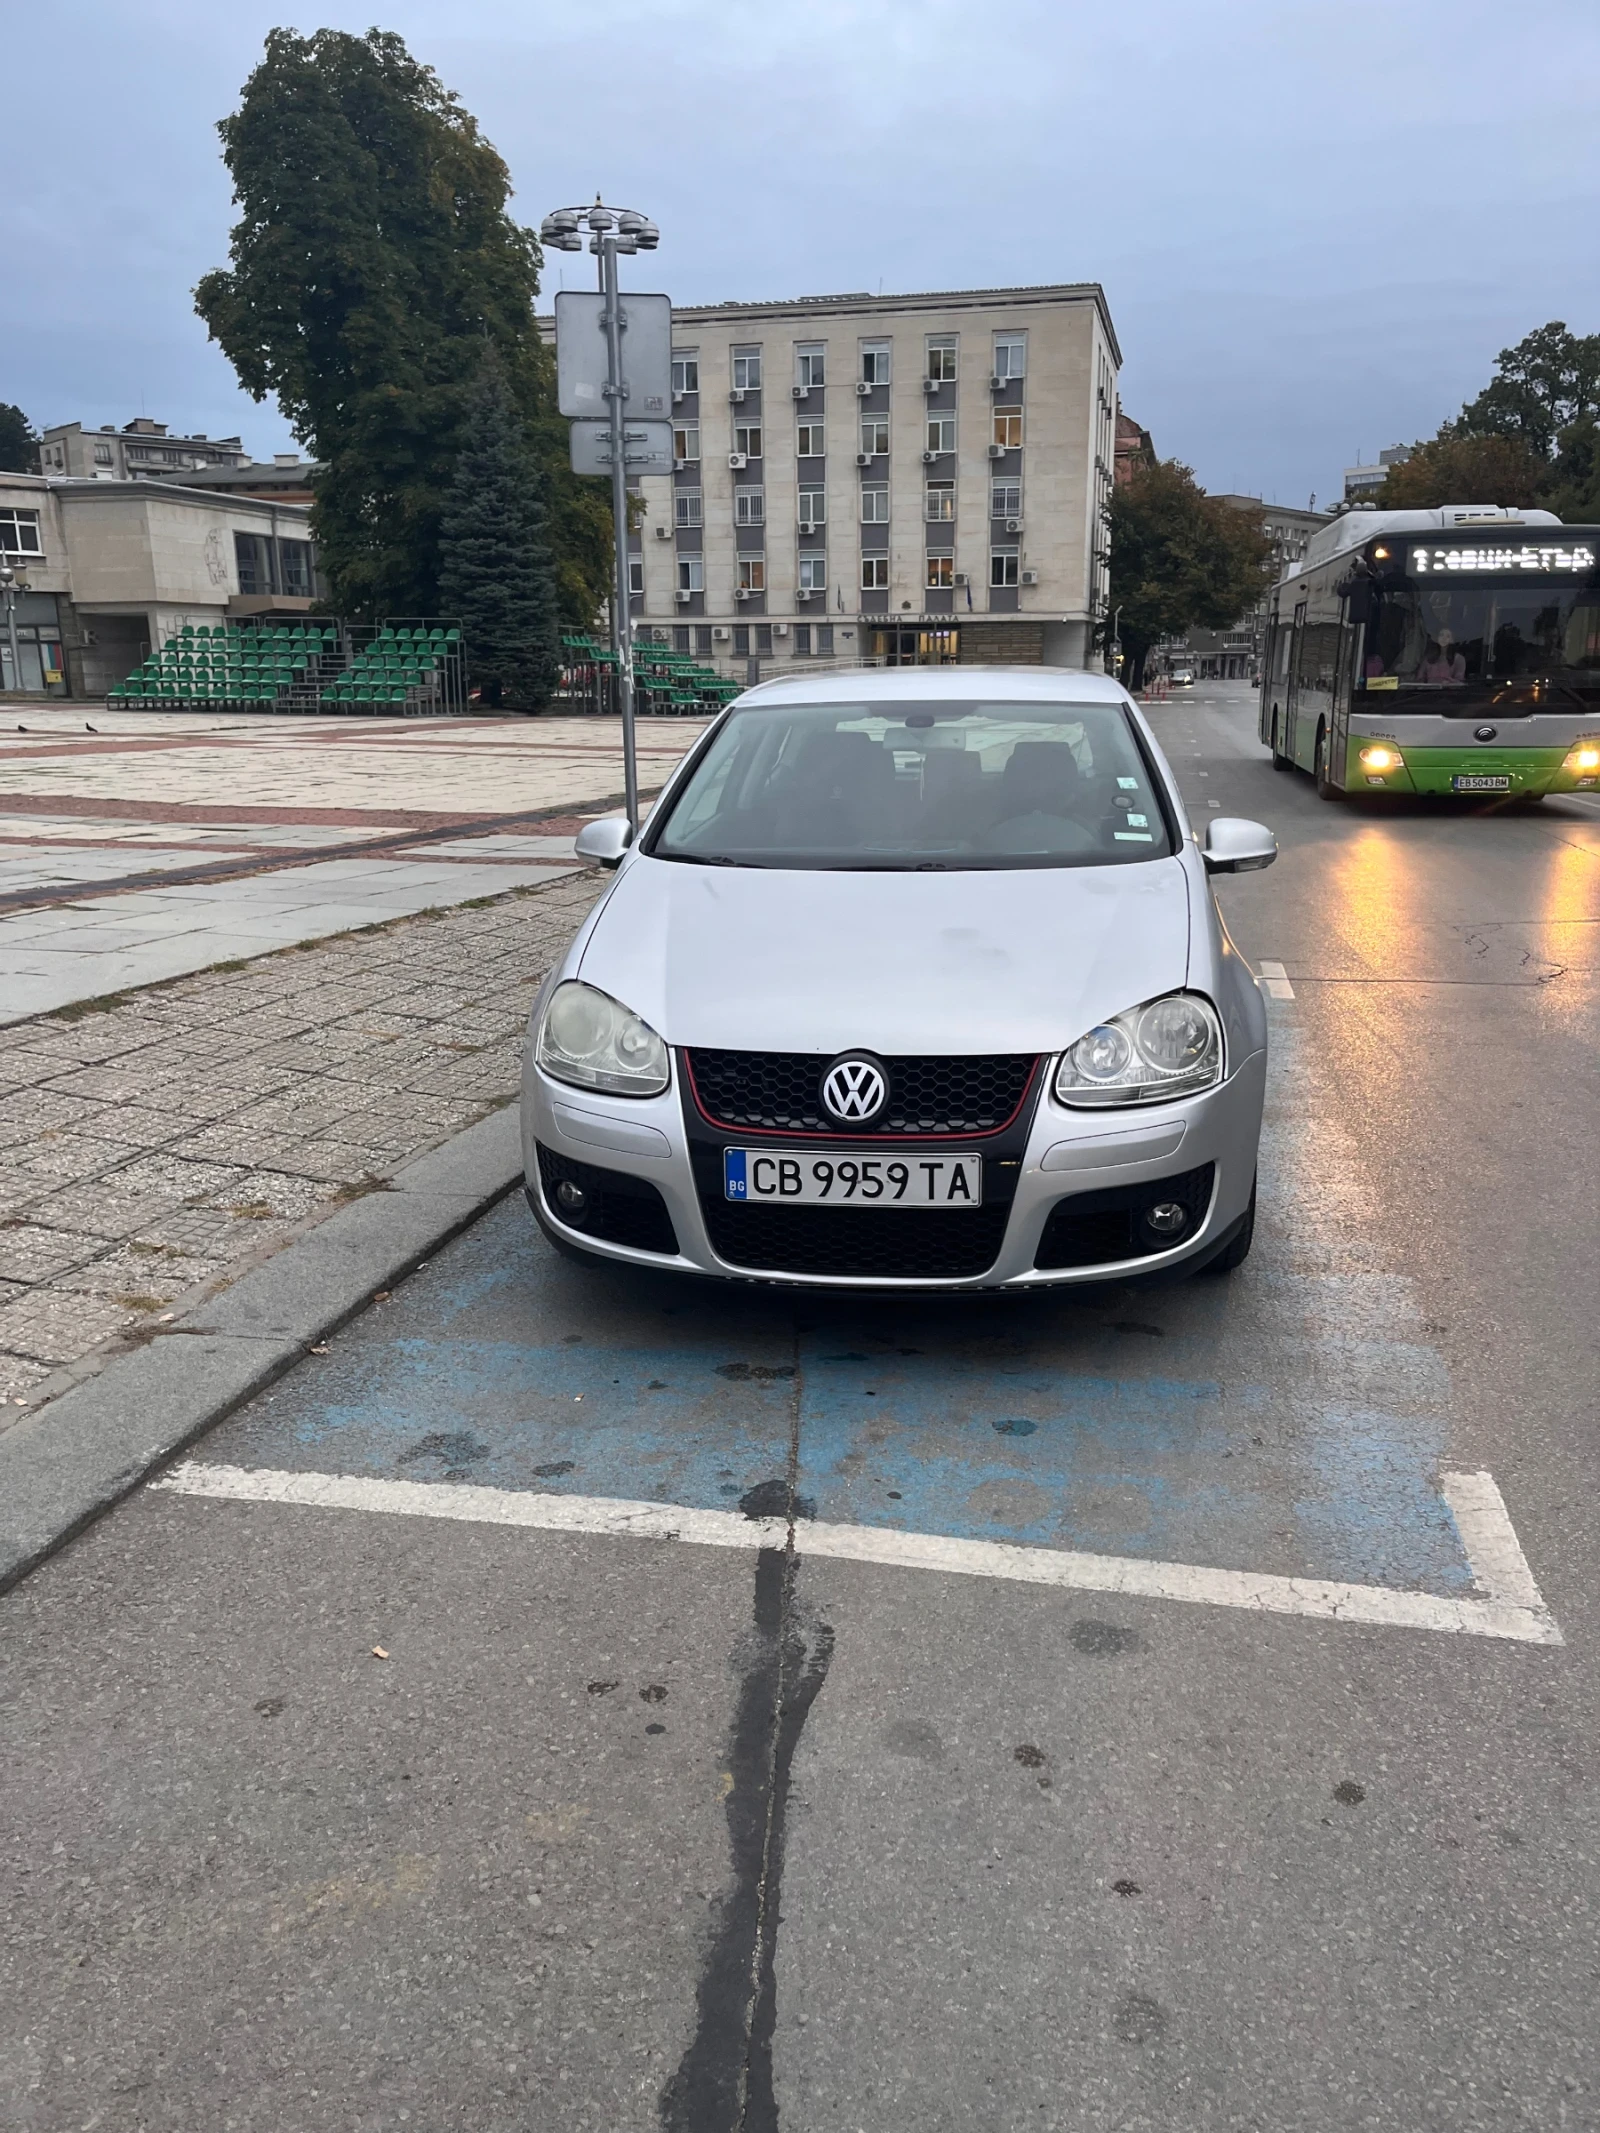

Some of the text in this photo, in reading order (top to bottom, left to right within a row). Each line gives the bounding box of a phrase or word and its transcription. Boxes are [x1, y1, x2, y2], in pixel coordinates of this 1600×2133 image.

[857, 614, 959, 622] СЪДЕБНА ПАЛАТА
[1472, 779, 1494, 787] 5043
[823, 1061, 884, 1120] VW
[753, 1158, 971, 1200] CB 9959 TA
[729, 1180, 745, 1192] BG
